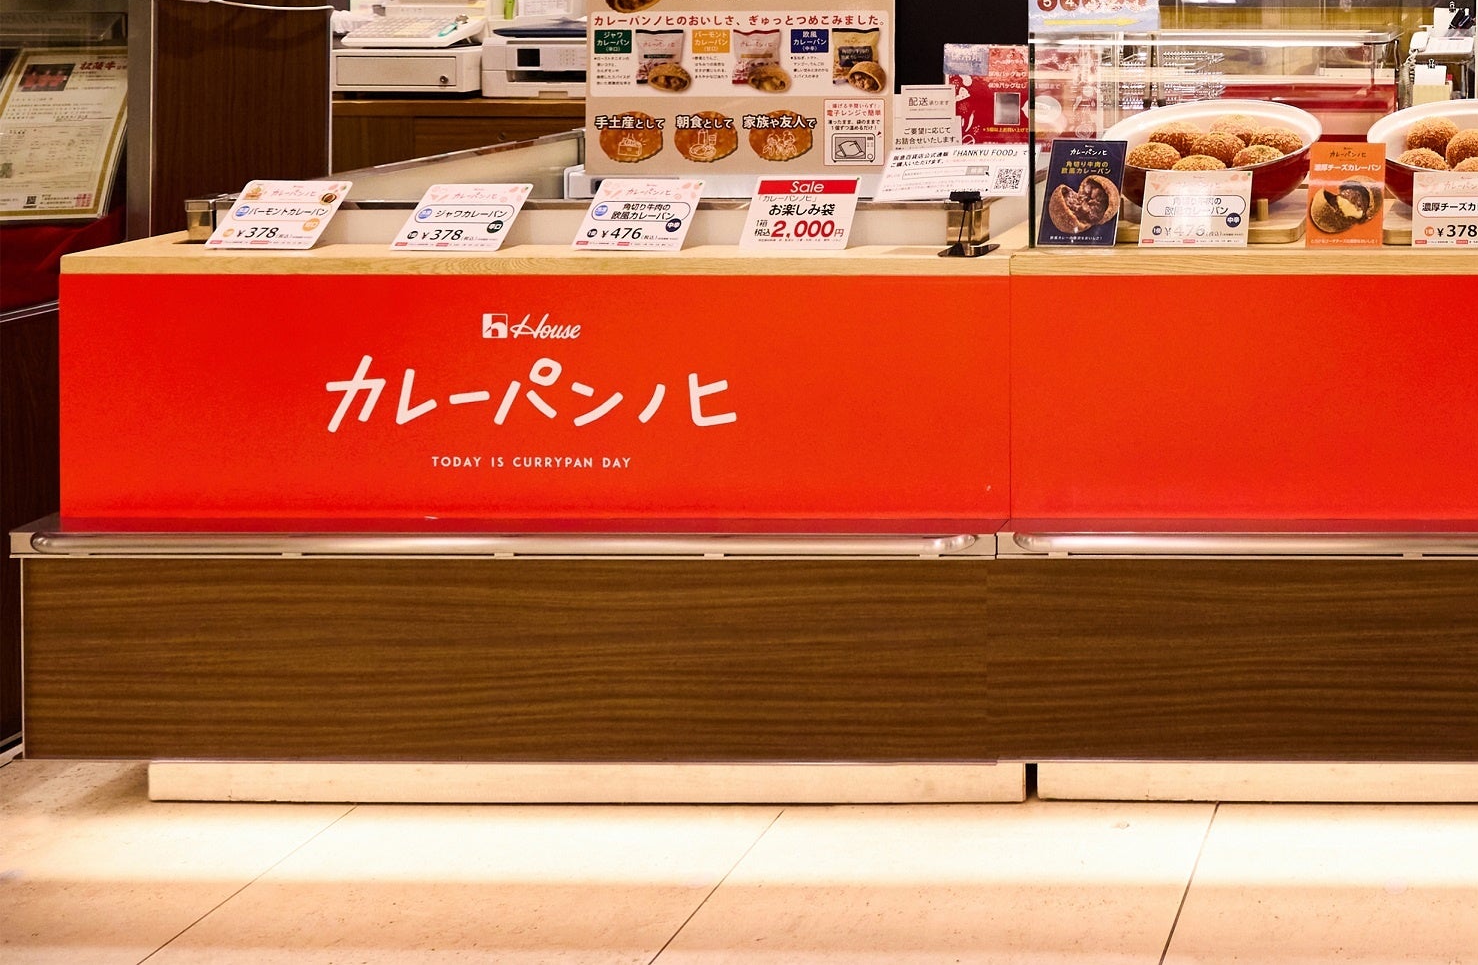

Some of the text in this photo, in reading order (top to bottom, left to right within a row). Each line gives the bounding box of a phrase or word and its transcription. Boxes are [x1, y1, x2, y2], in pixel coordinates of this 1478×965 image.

[748, 15, 885, 26] ぎゅっとつめこみました。
[793, 38, 827, 46] カレーパン
[594, 115, 665, 130] 手土産として
[675, 115, 734, 130] 朝食として
[743, 115, 816, 129] 家族や友人で
[904, 127, 951, 135] ご要望に応じて
[790, 181, 824, 193] Sale
[435, 210, 508, 218] ジャワカレーパン
[769, 203, 835, 216] お楽しみ袋
[611, 212, 675, 220] 欧風カレーパン
[1437, 225, 1477, 237] ¥378
[509, 313, 581, 339] House
[326, 354, 737, 433] カレーパンノヒ
[431, 456, 632, 469] TODAY IS CURRYPAN DAY
